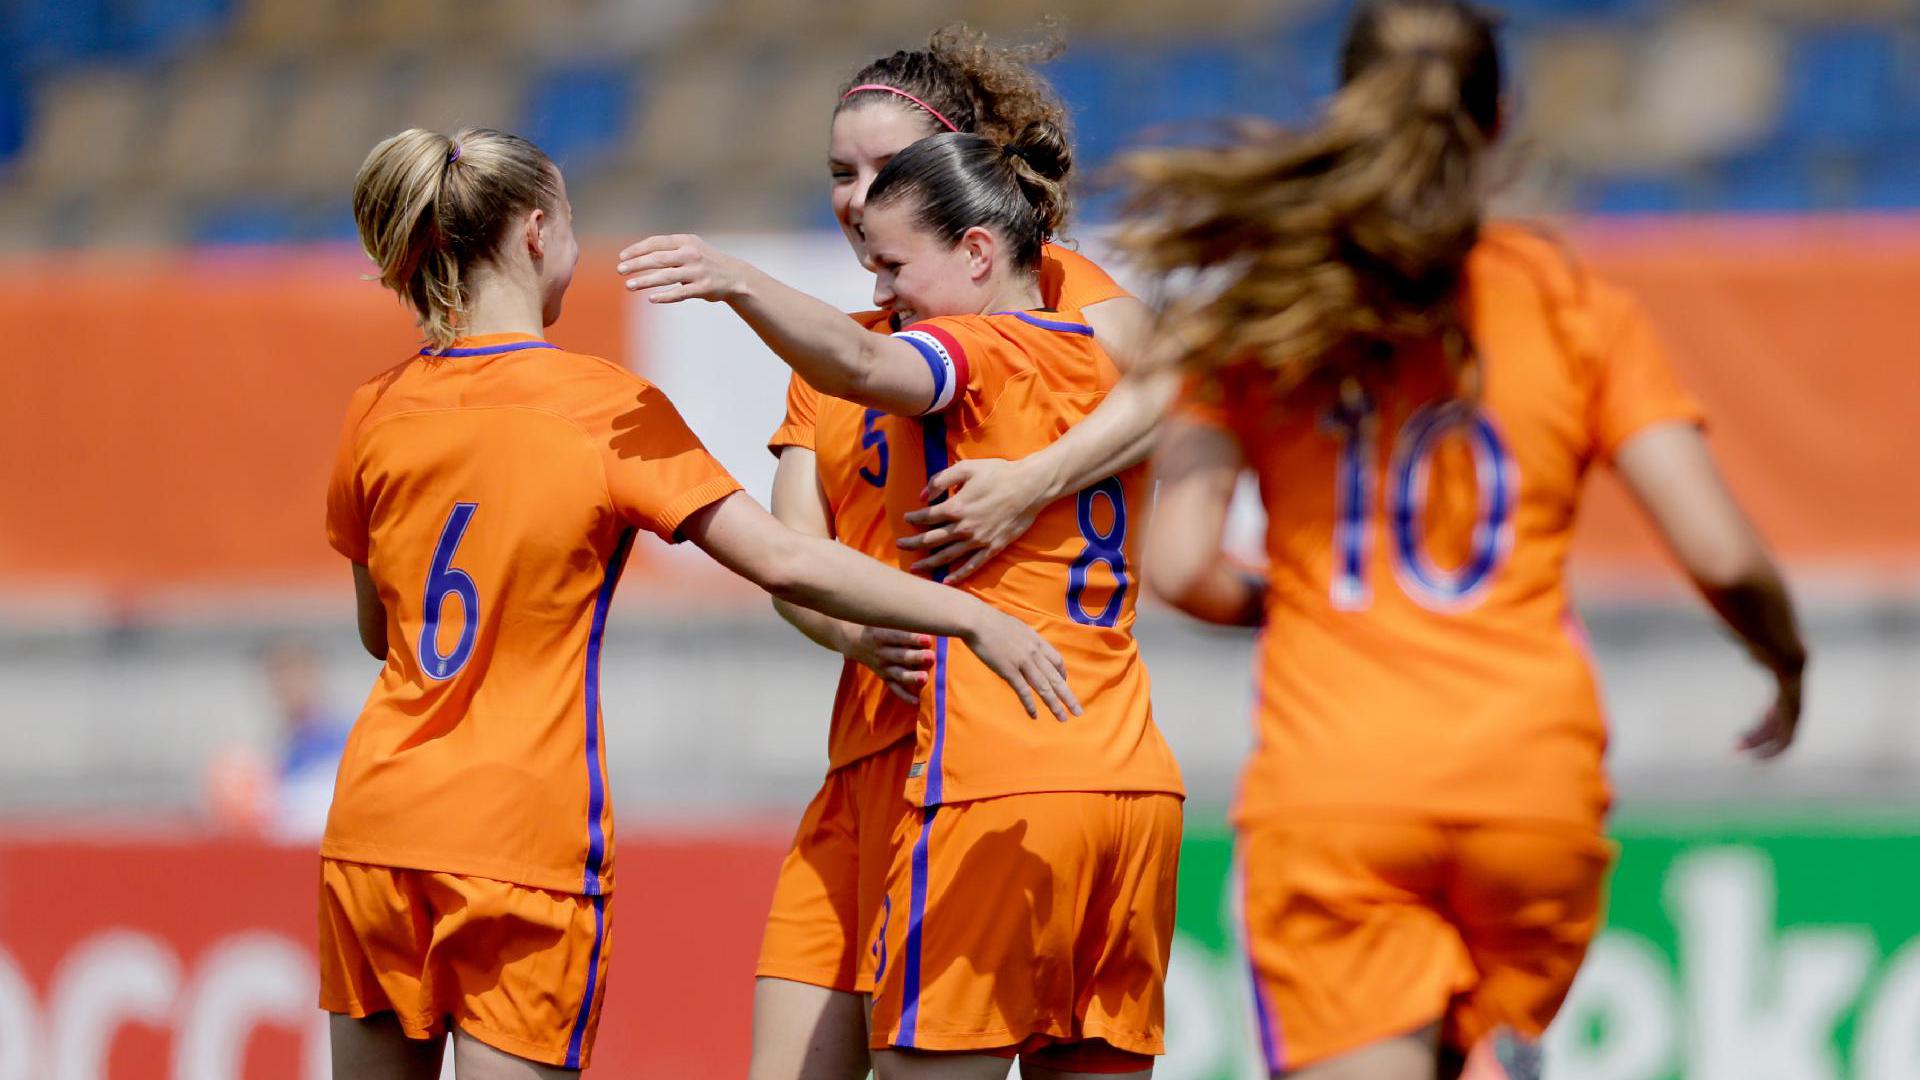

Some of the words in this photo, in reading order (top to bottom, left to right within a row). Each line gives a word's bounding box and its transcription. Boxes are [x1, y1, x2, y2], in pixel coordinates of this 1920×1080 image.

[859, 409, 889, 488] 5
[1318, 397, 1521, 614] 10
[418, 502, 480, 681] 6
[1065, 474, 1129, 628] 8
